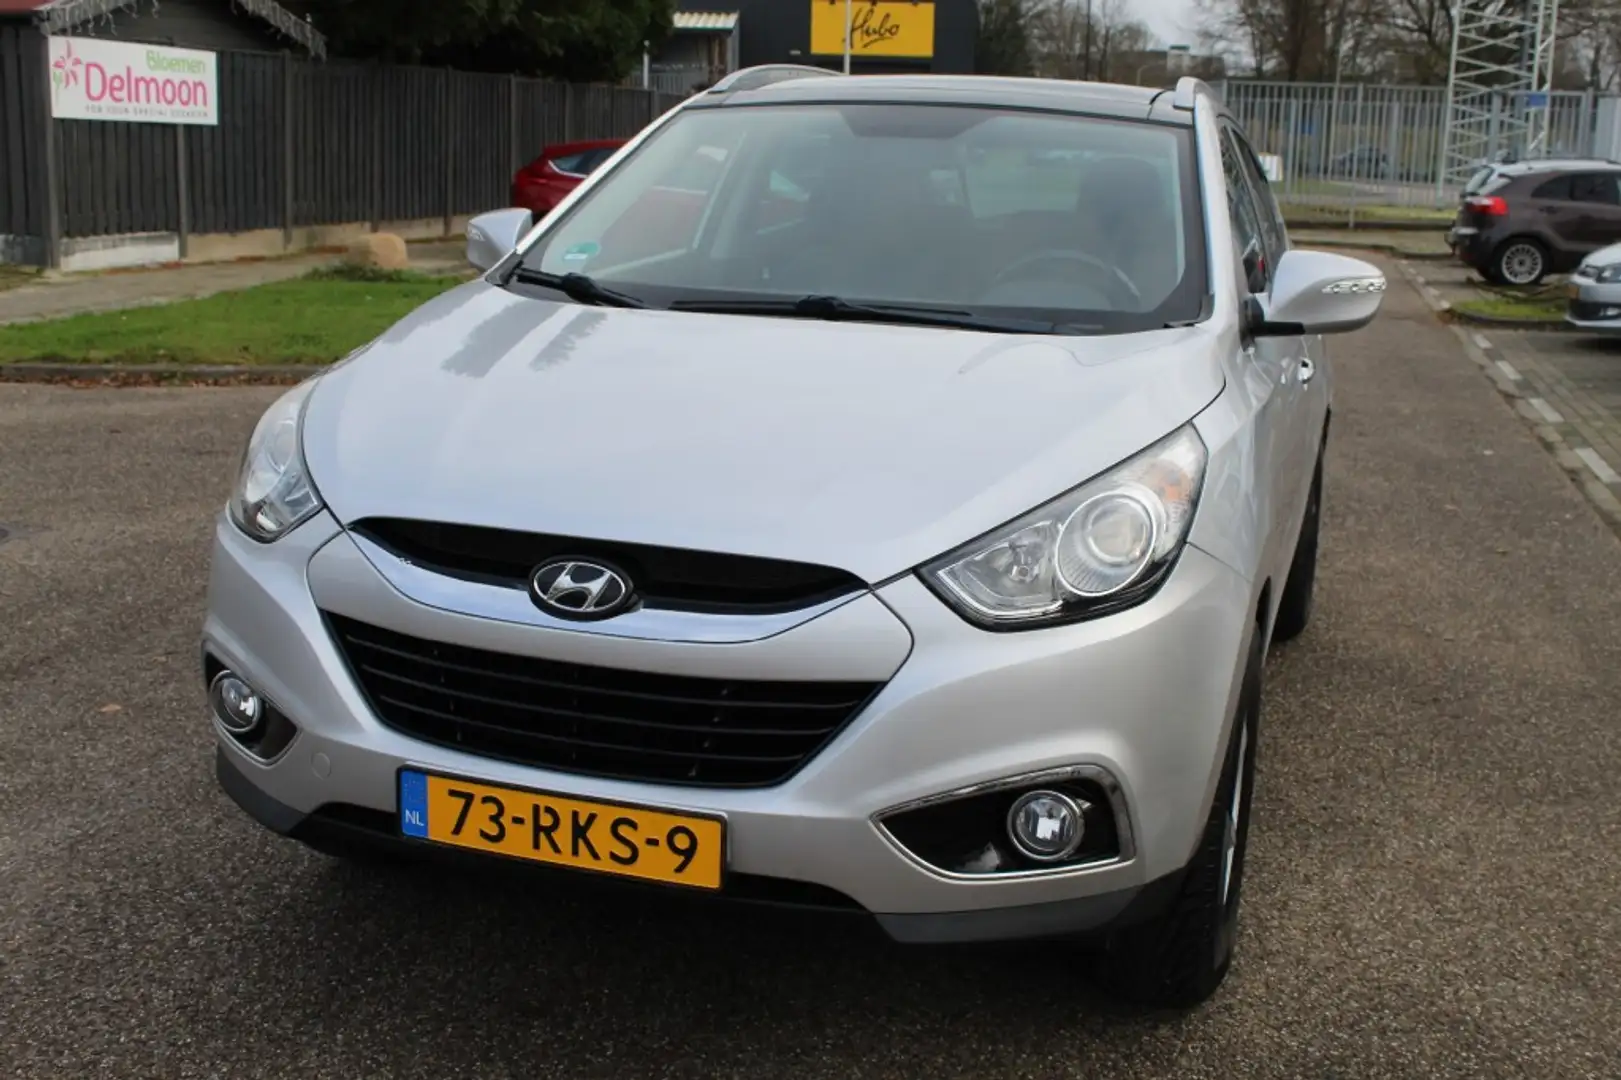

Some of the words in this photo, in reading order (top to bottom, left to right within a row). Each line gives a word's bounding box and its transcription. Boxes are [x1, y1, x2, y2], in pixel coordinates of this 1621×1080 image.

[843, 7, 900, 49] Hubo
[146, 50, 206, 74] Bloemen
[85, 62, 208, 107] Delmoon
[404, 809, 425, 827] NL
[447, 788, 699, 874] 73-RKS-9
